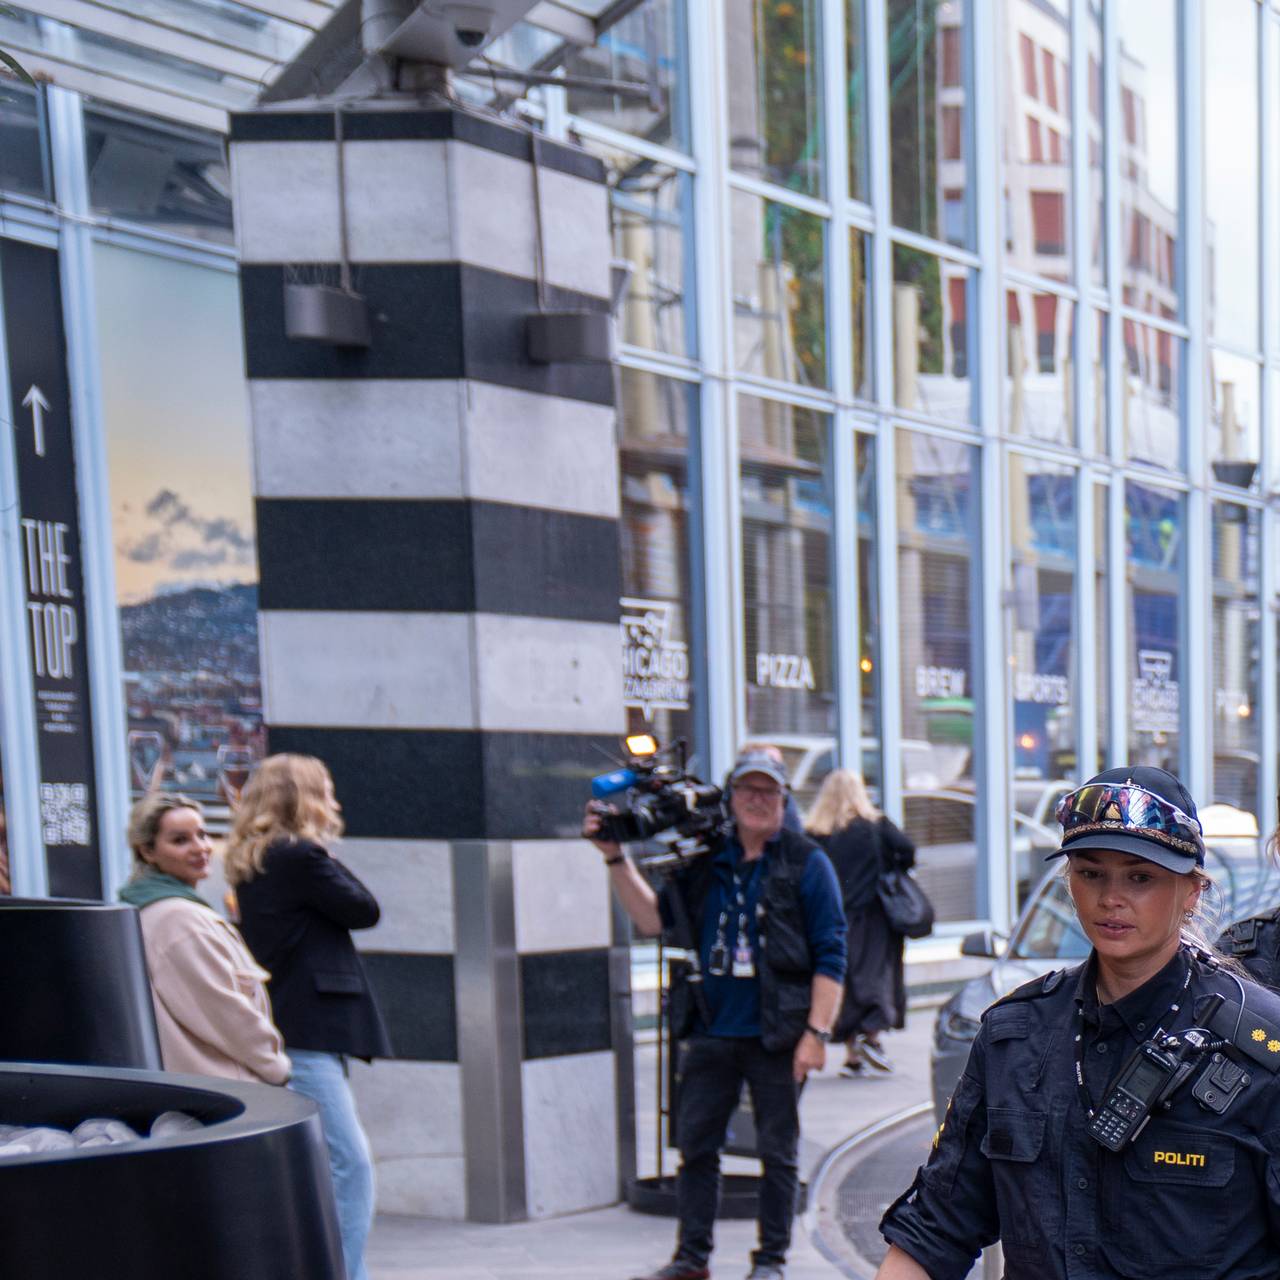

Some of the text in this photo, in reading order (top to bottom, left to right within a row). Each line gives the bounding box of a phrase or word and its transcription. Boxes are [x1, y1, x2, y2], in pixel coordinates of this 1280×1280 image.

[22, 518, 73, 598] THE
[27, 601, 77, 679] TOP
[756, 652, 816, 690] PIZZA
[915, 665, 965, 698] BREW
[1154, 1151, 1205, 1167] POLITI
